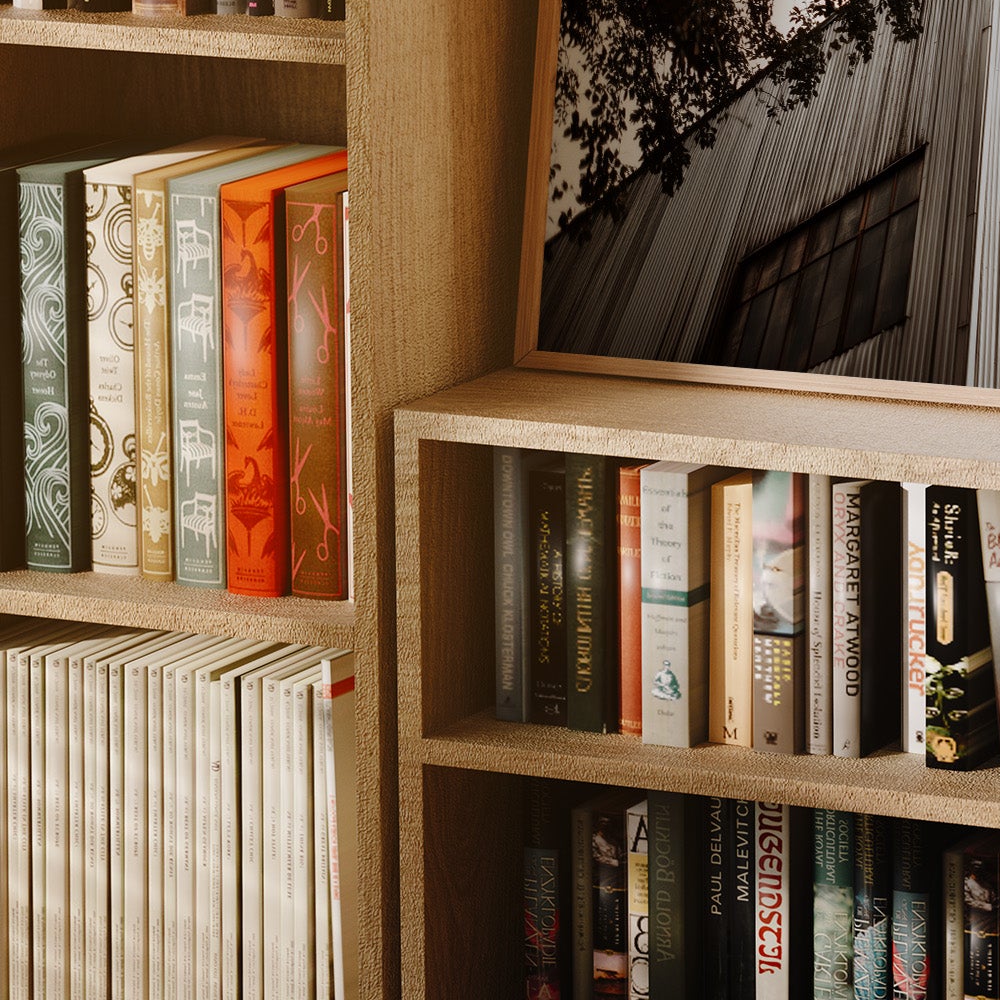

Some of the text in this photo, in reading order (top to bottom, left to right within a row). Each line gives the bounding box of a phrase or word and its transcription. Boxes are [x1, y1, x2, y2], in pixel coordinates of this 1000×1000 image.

[650, 537, 682, 549] Theory
[834, 492, 845, 669] ORYX AND CRAKE
[846, 493, 859, 697] MARGARET ATWOOD
[710, 799, 722, 916] PAUL DELVAU
